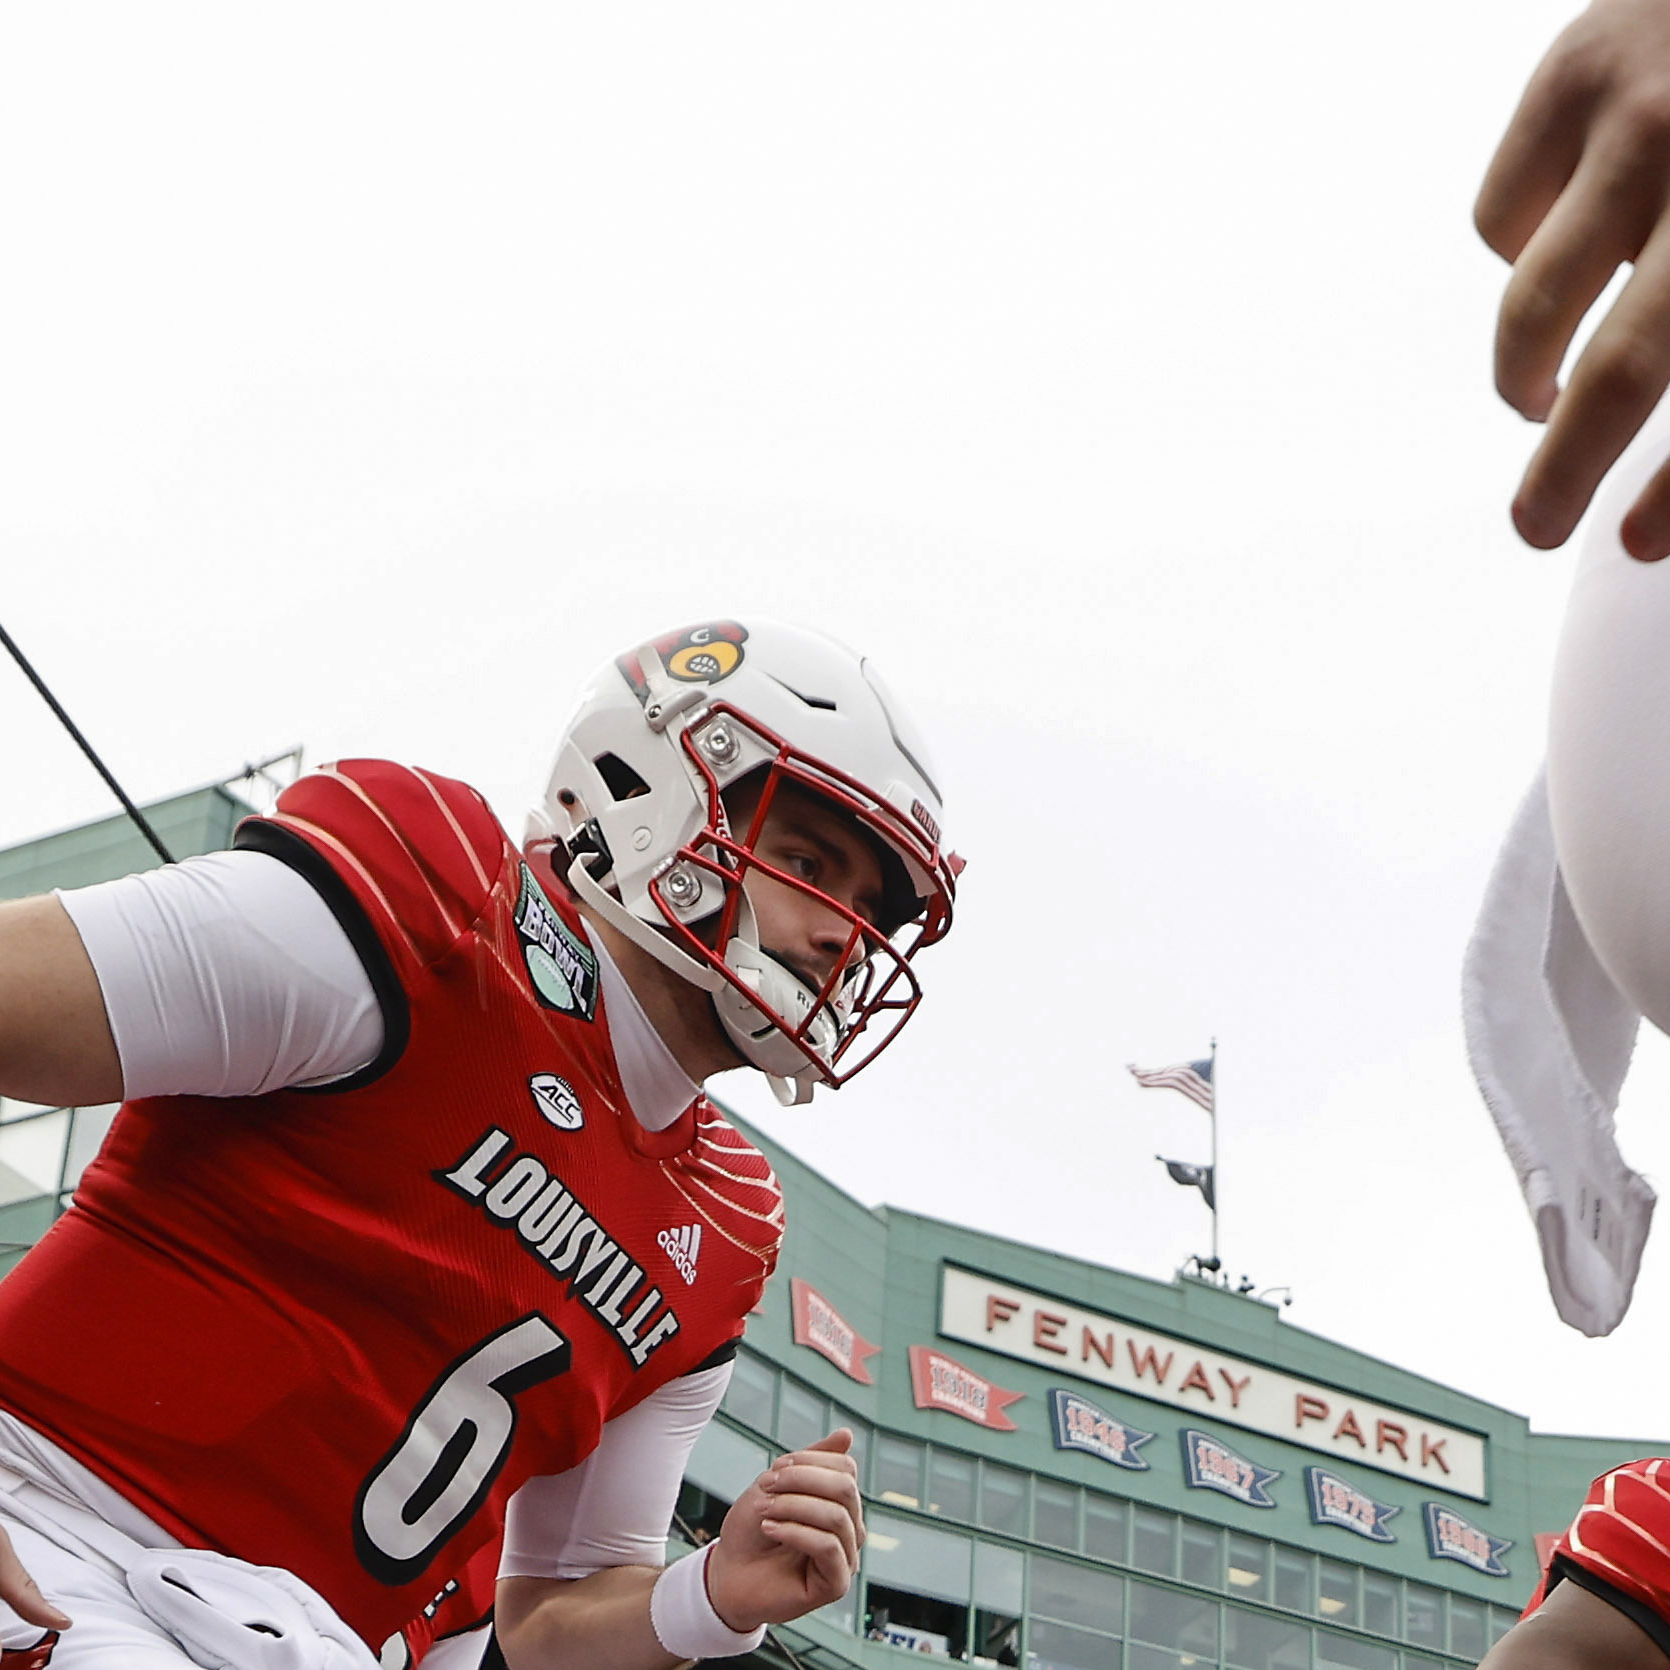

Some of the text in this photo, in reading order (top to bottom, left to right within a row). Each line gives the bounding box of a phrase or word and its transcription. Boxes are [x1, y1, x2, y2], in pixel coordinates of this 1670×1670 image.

[519, 893, 587, 1013] BOWL
[539, 1084, 584, 1125] ACC
[444, 1128, 680, 1366] LOUISVILLE
[657, 1230, 697, 1286] adidas
[361, 1314, 567, 1562] 6
[986, 1294, 1451, 1474] FENWAY PARK
